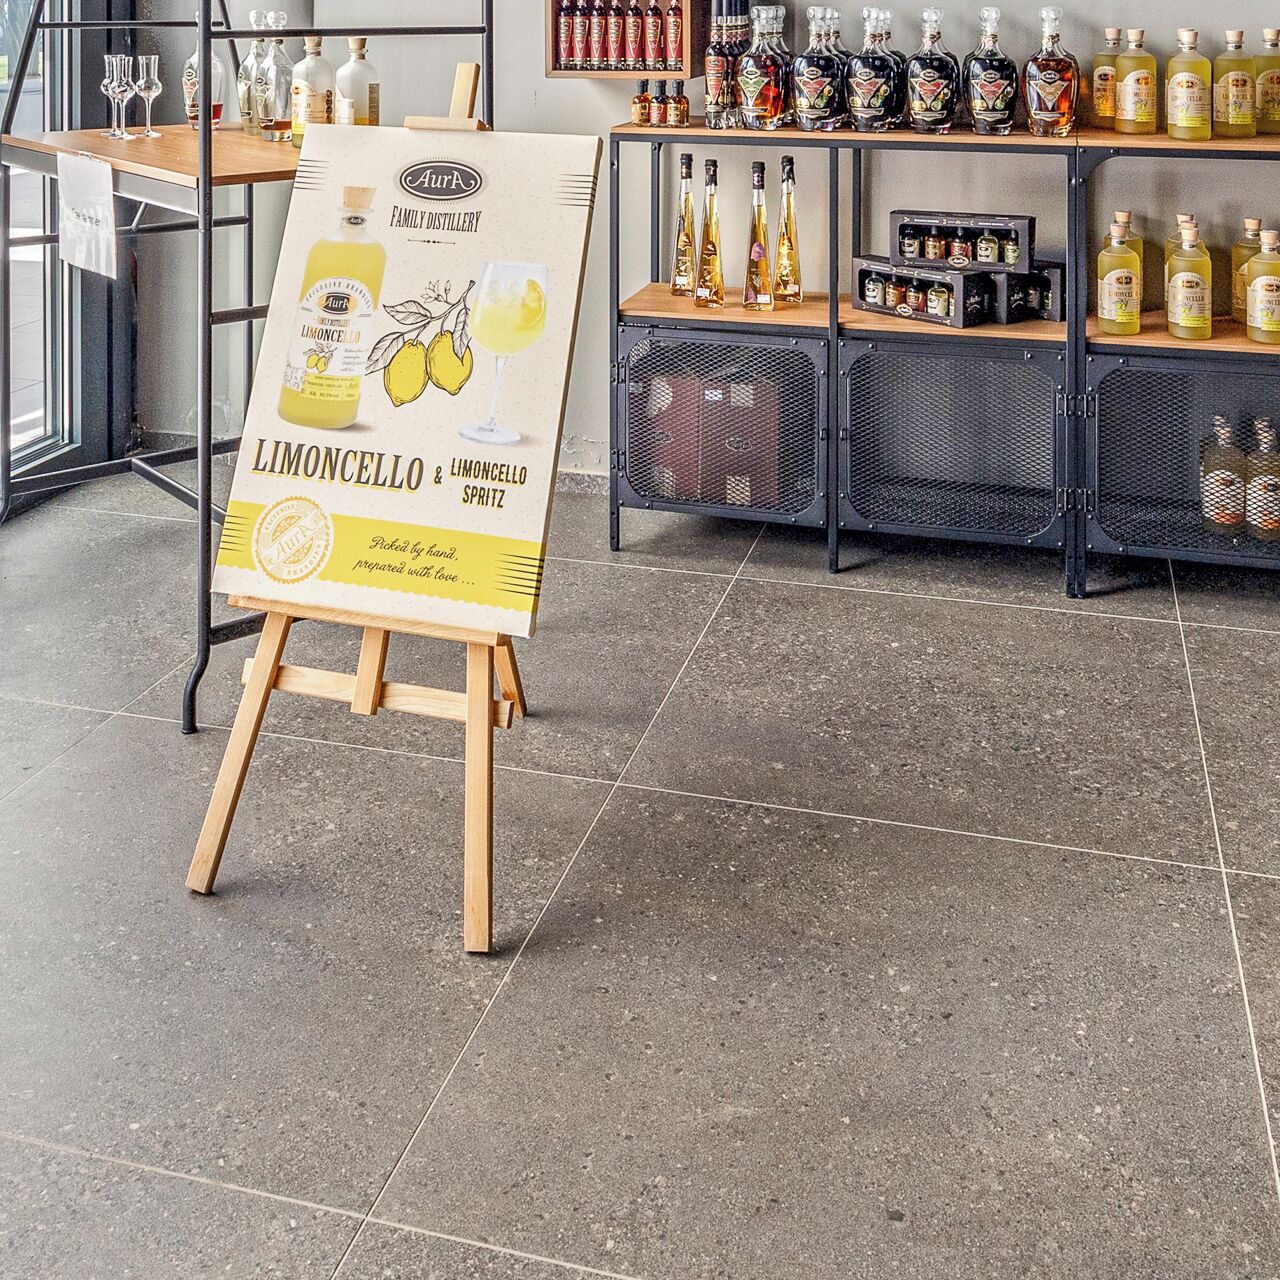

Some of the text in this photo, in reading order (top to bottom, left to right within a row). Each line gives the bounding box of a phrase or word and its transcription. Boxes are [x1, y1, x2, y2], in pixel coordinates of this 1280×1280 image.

[407, 169, 475, 190] AurA
[390, 205, 482, 233] FAMILY DISTILLERY
[301, 325, 361, 343] LIMONCELLO
[251, 438, 443, 491] LIMONCELLO &
[450, 458, 527, 485] LIMONCELLO
[462, 485, 506, 508] SPRITZ
[369, 537, 460, 562] Picked by hand,
[352, 559, 406, 579] prepared
[407, 565, 433, 580] with
[434, 569, 459, 583] love
